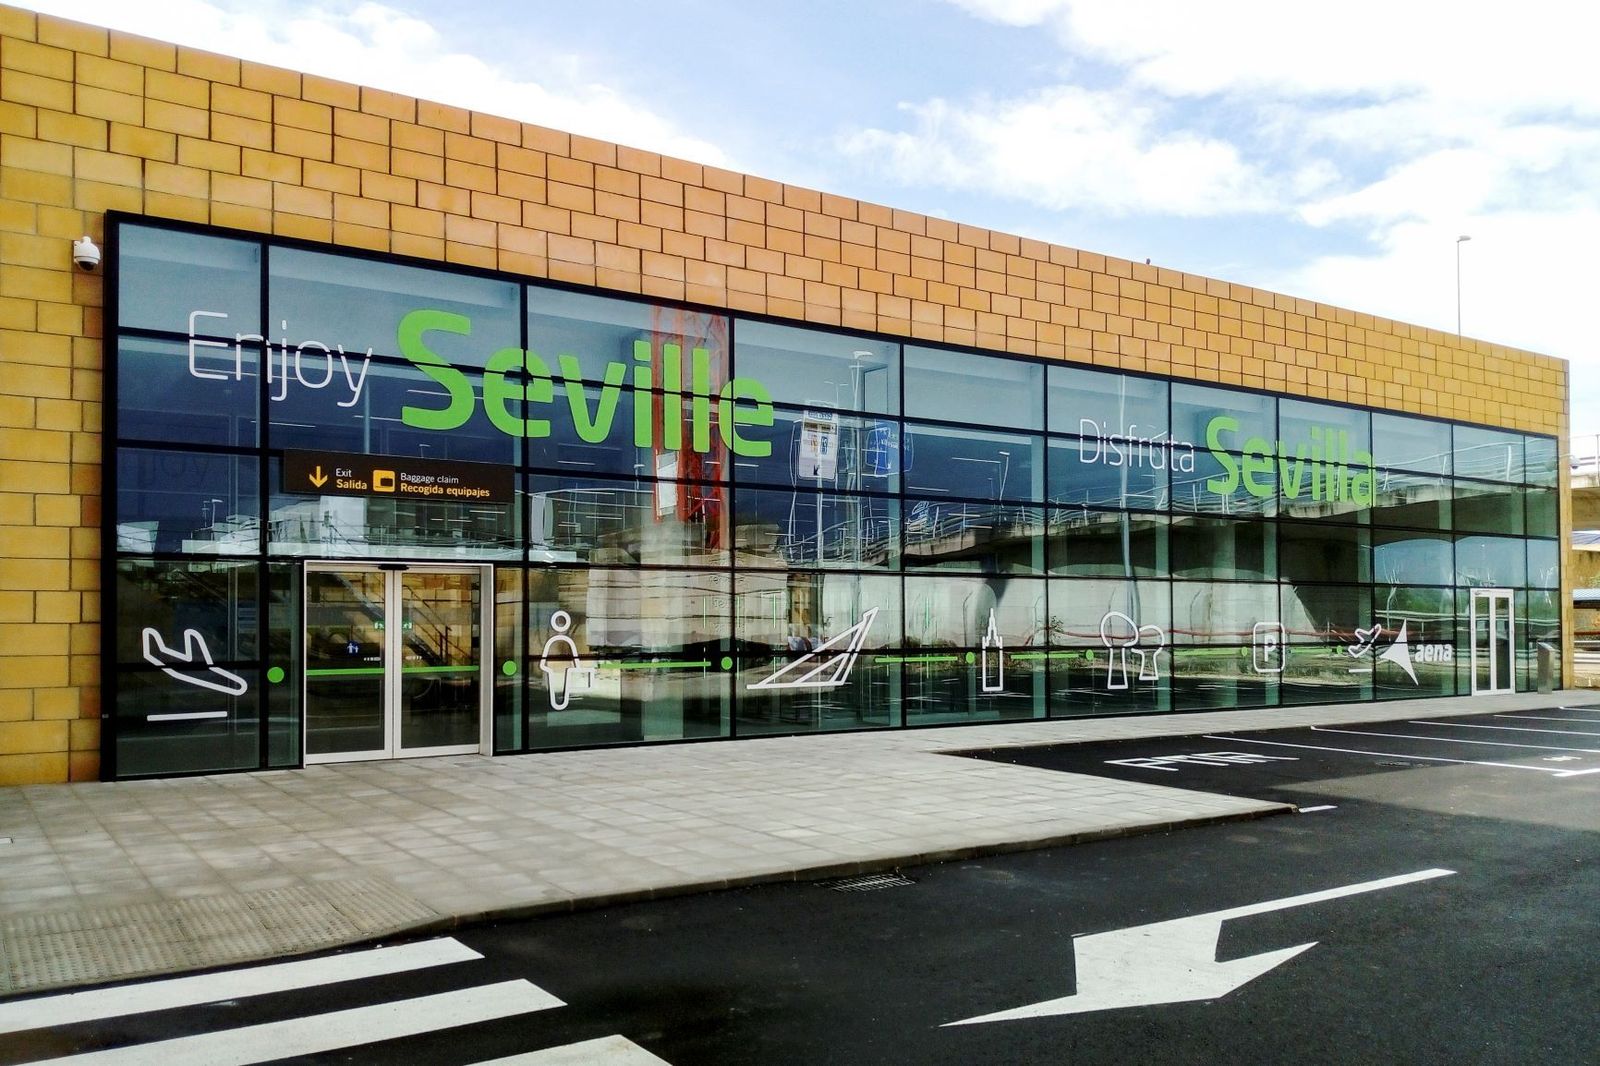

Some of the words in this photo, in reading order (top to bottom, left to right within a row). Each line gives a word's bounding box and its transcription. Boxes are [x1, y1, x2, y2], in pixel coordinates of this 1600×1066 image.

[188, 309, 373, 408] Enjoy
[397, 308, 775, 458] Seville
[1079, 418, 1195, 473] Disfruta
[1206, 416, 1377, 507] Sevilla
[335, 468, 352, 477] Exit
[400, 472, 435, 484] Baggage
[436, 475, 459, 484] claim
[336, 479, 368, 490] Salida
[400, 482, 444, 495] Recogida
[446, 486, 490, 498] equipajes
[1264, 634, 1277, 662] P
[1415, 643, 1453, 663] aena
